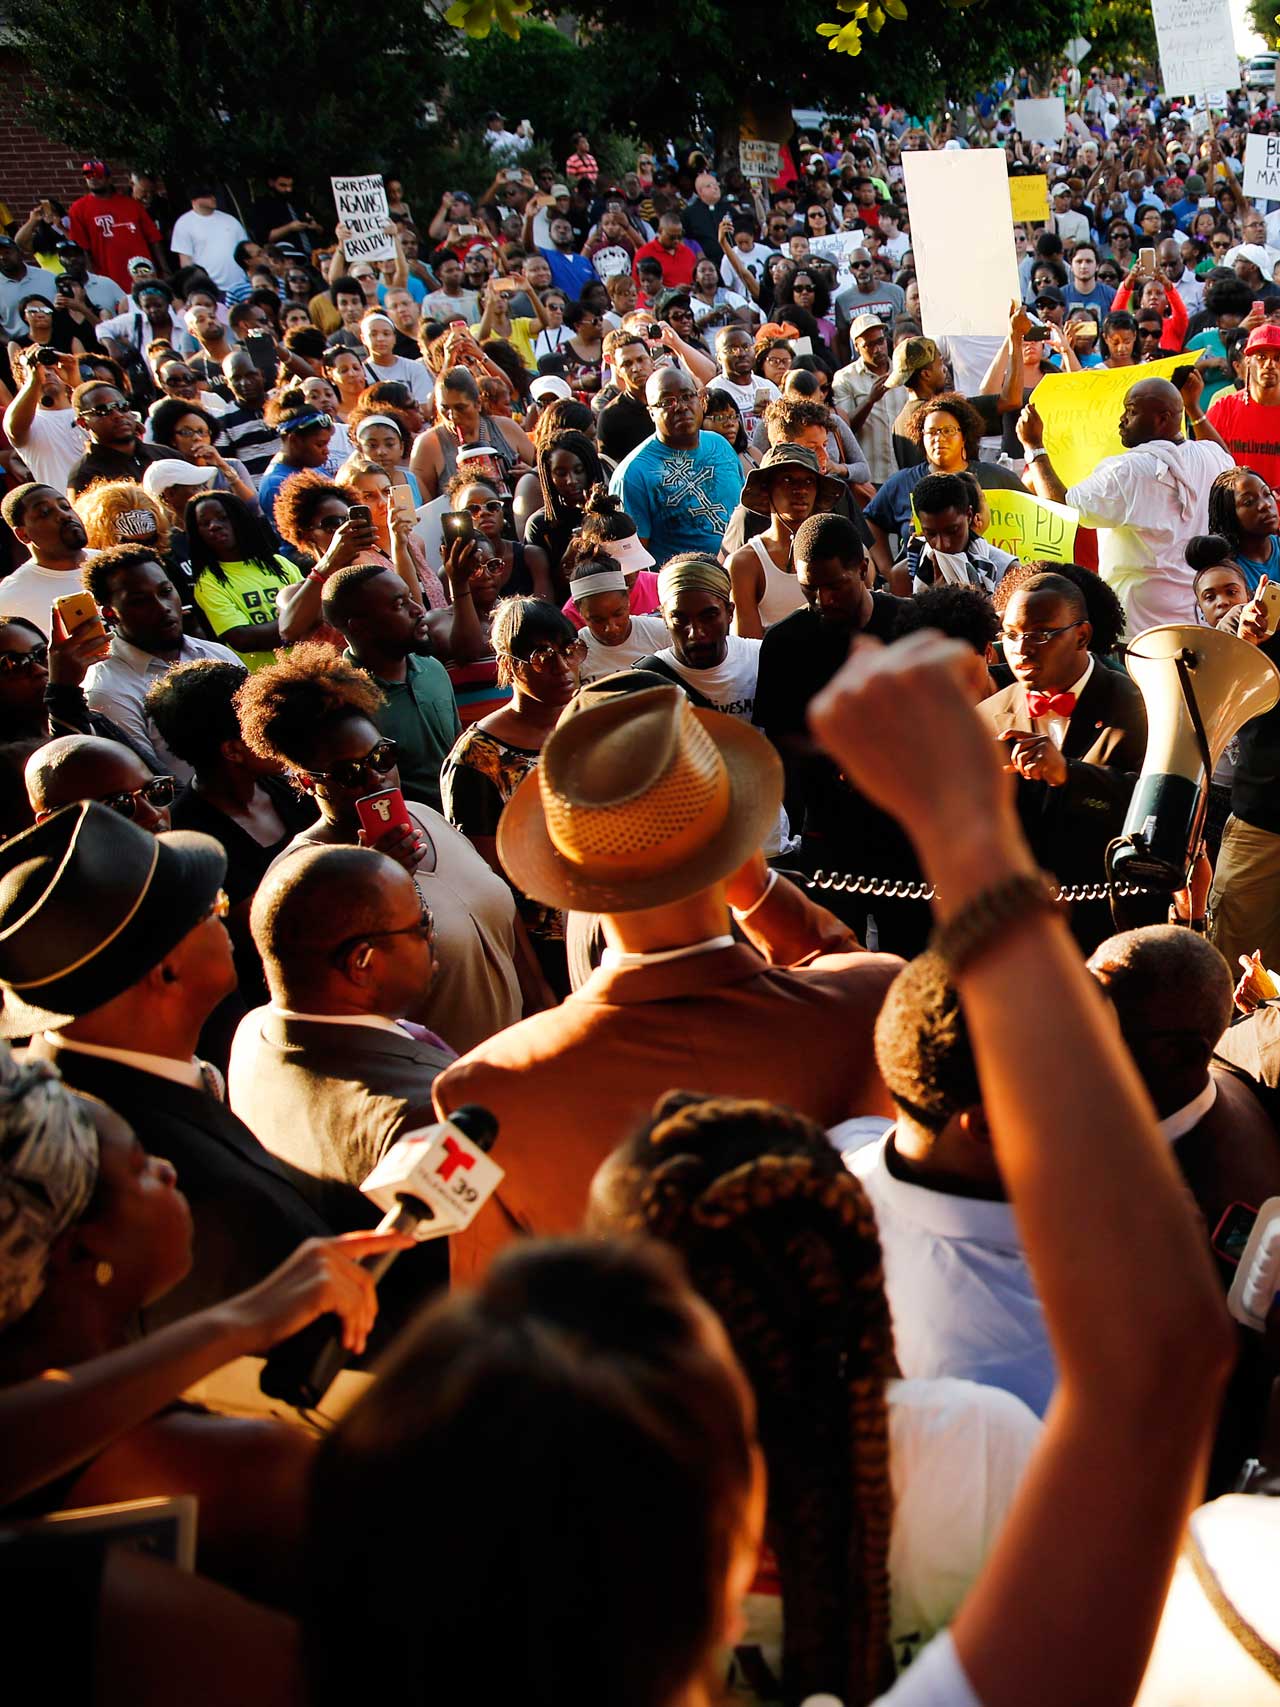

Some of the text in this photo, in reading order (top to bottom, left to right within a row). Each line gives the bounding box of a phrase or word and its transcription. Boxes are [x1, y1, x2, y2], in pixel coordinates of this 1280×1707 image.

[340, 192, 385, 214] AGAINST
[849, 303, 893, 318] RUN DMC
[1036, 504, 1065, 545] PD
[452, 1177, 478, 1203] 39
